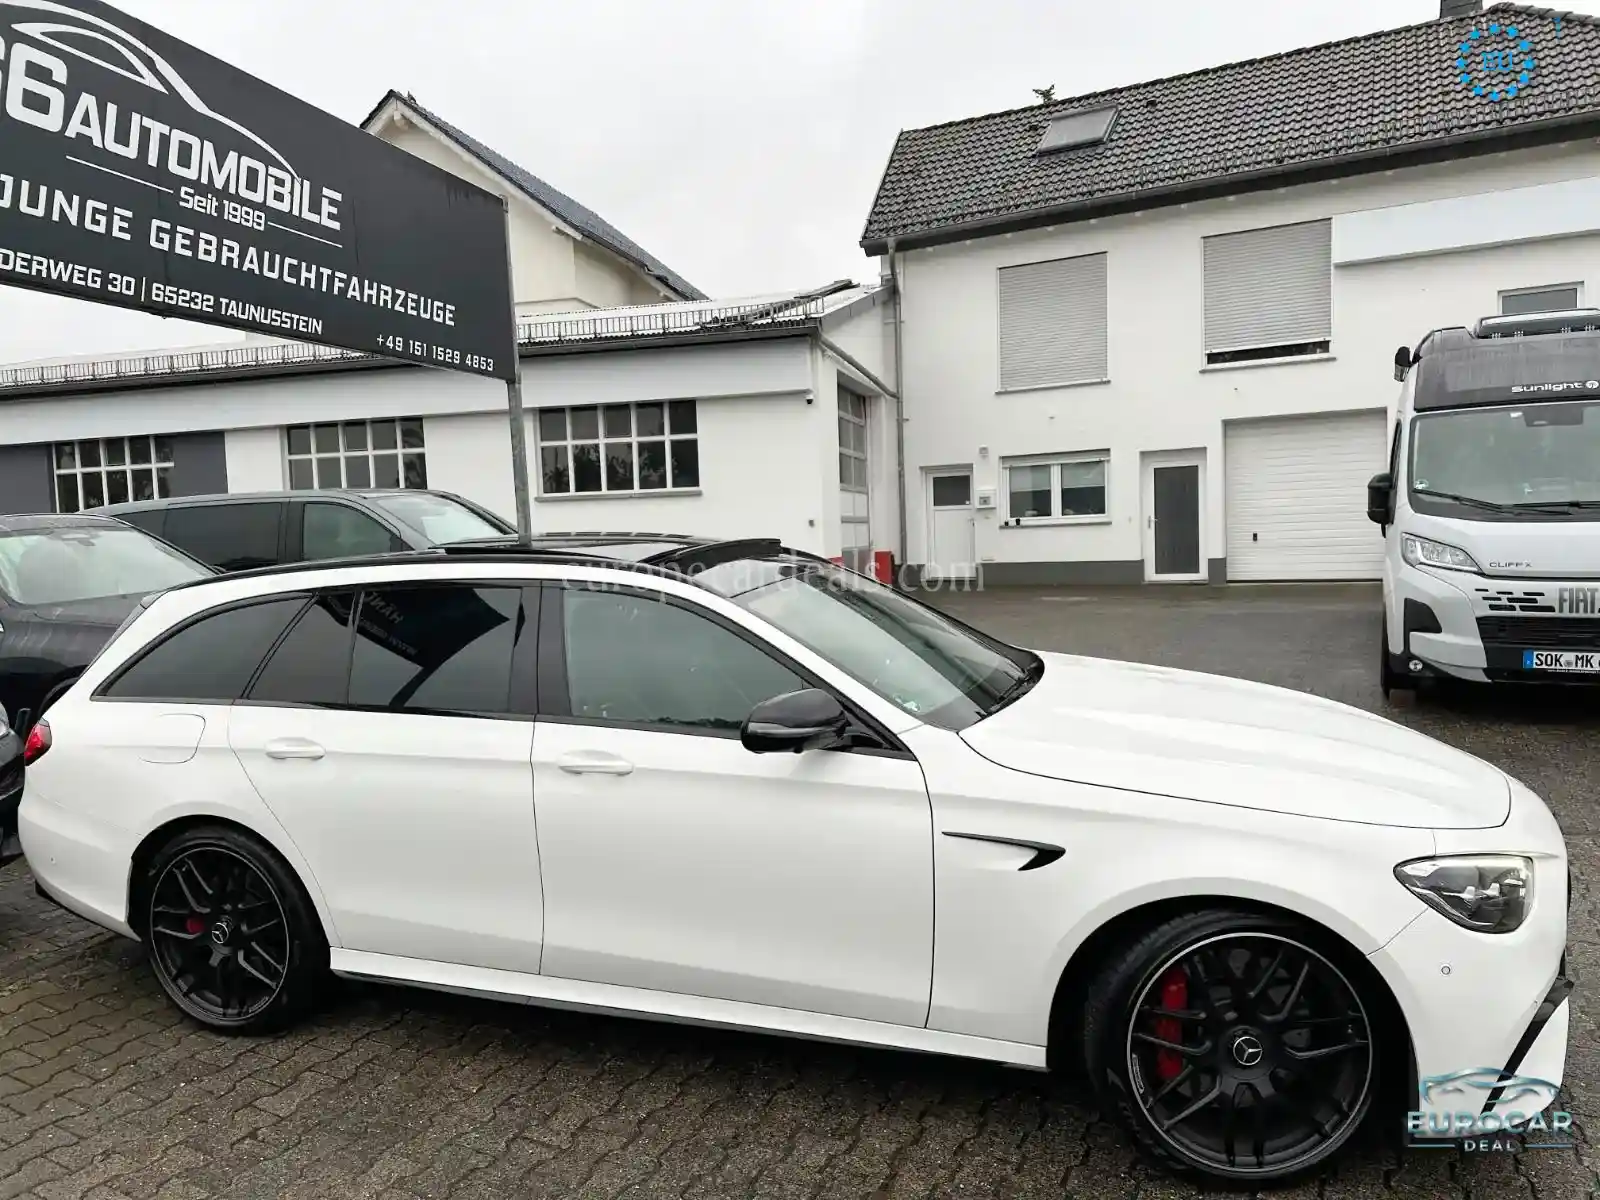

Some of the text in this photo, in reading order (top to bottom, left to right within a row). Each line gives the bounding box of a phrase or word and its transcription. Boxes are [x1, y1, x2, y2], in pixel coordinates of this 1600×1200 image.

[0, 35, 68, 133] 6
[179, 186, 266, 231] Seit 1999
[149, 218, 456, 327] GEBRAUCHTFAHRZEUGE
[107, 272, 136, 296] 30
[151, 282, 215, 313] 65232
[219, 297, 323, 335] TAUNUSSTEIN
[376, 333, 494, 371] +49 151 1529 4853
[1558, 587, 1599, 614] FIAT
[1535, 653, 1594, 669] SOK MK
